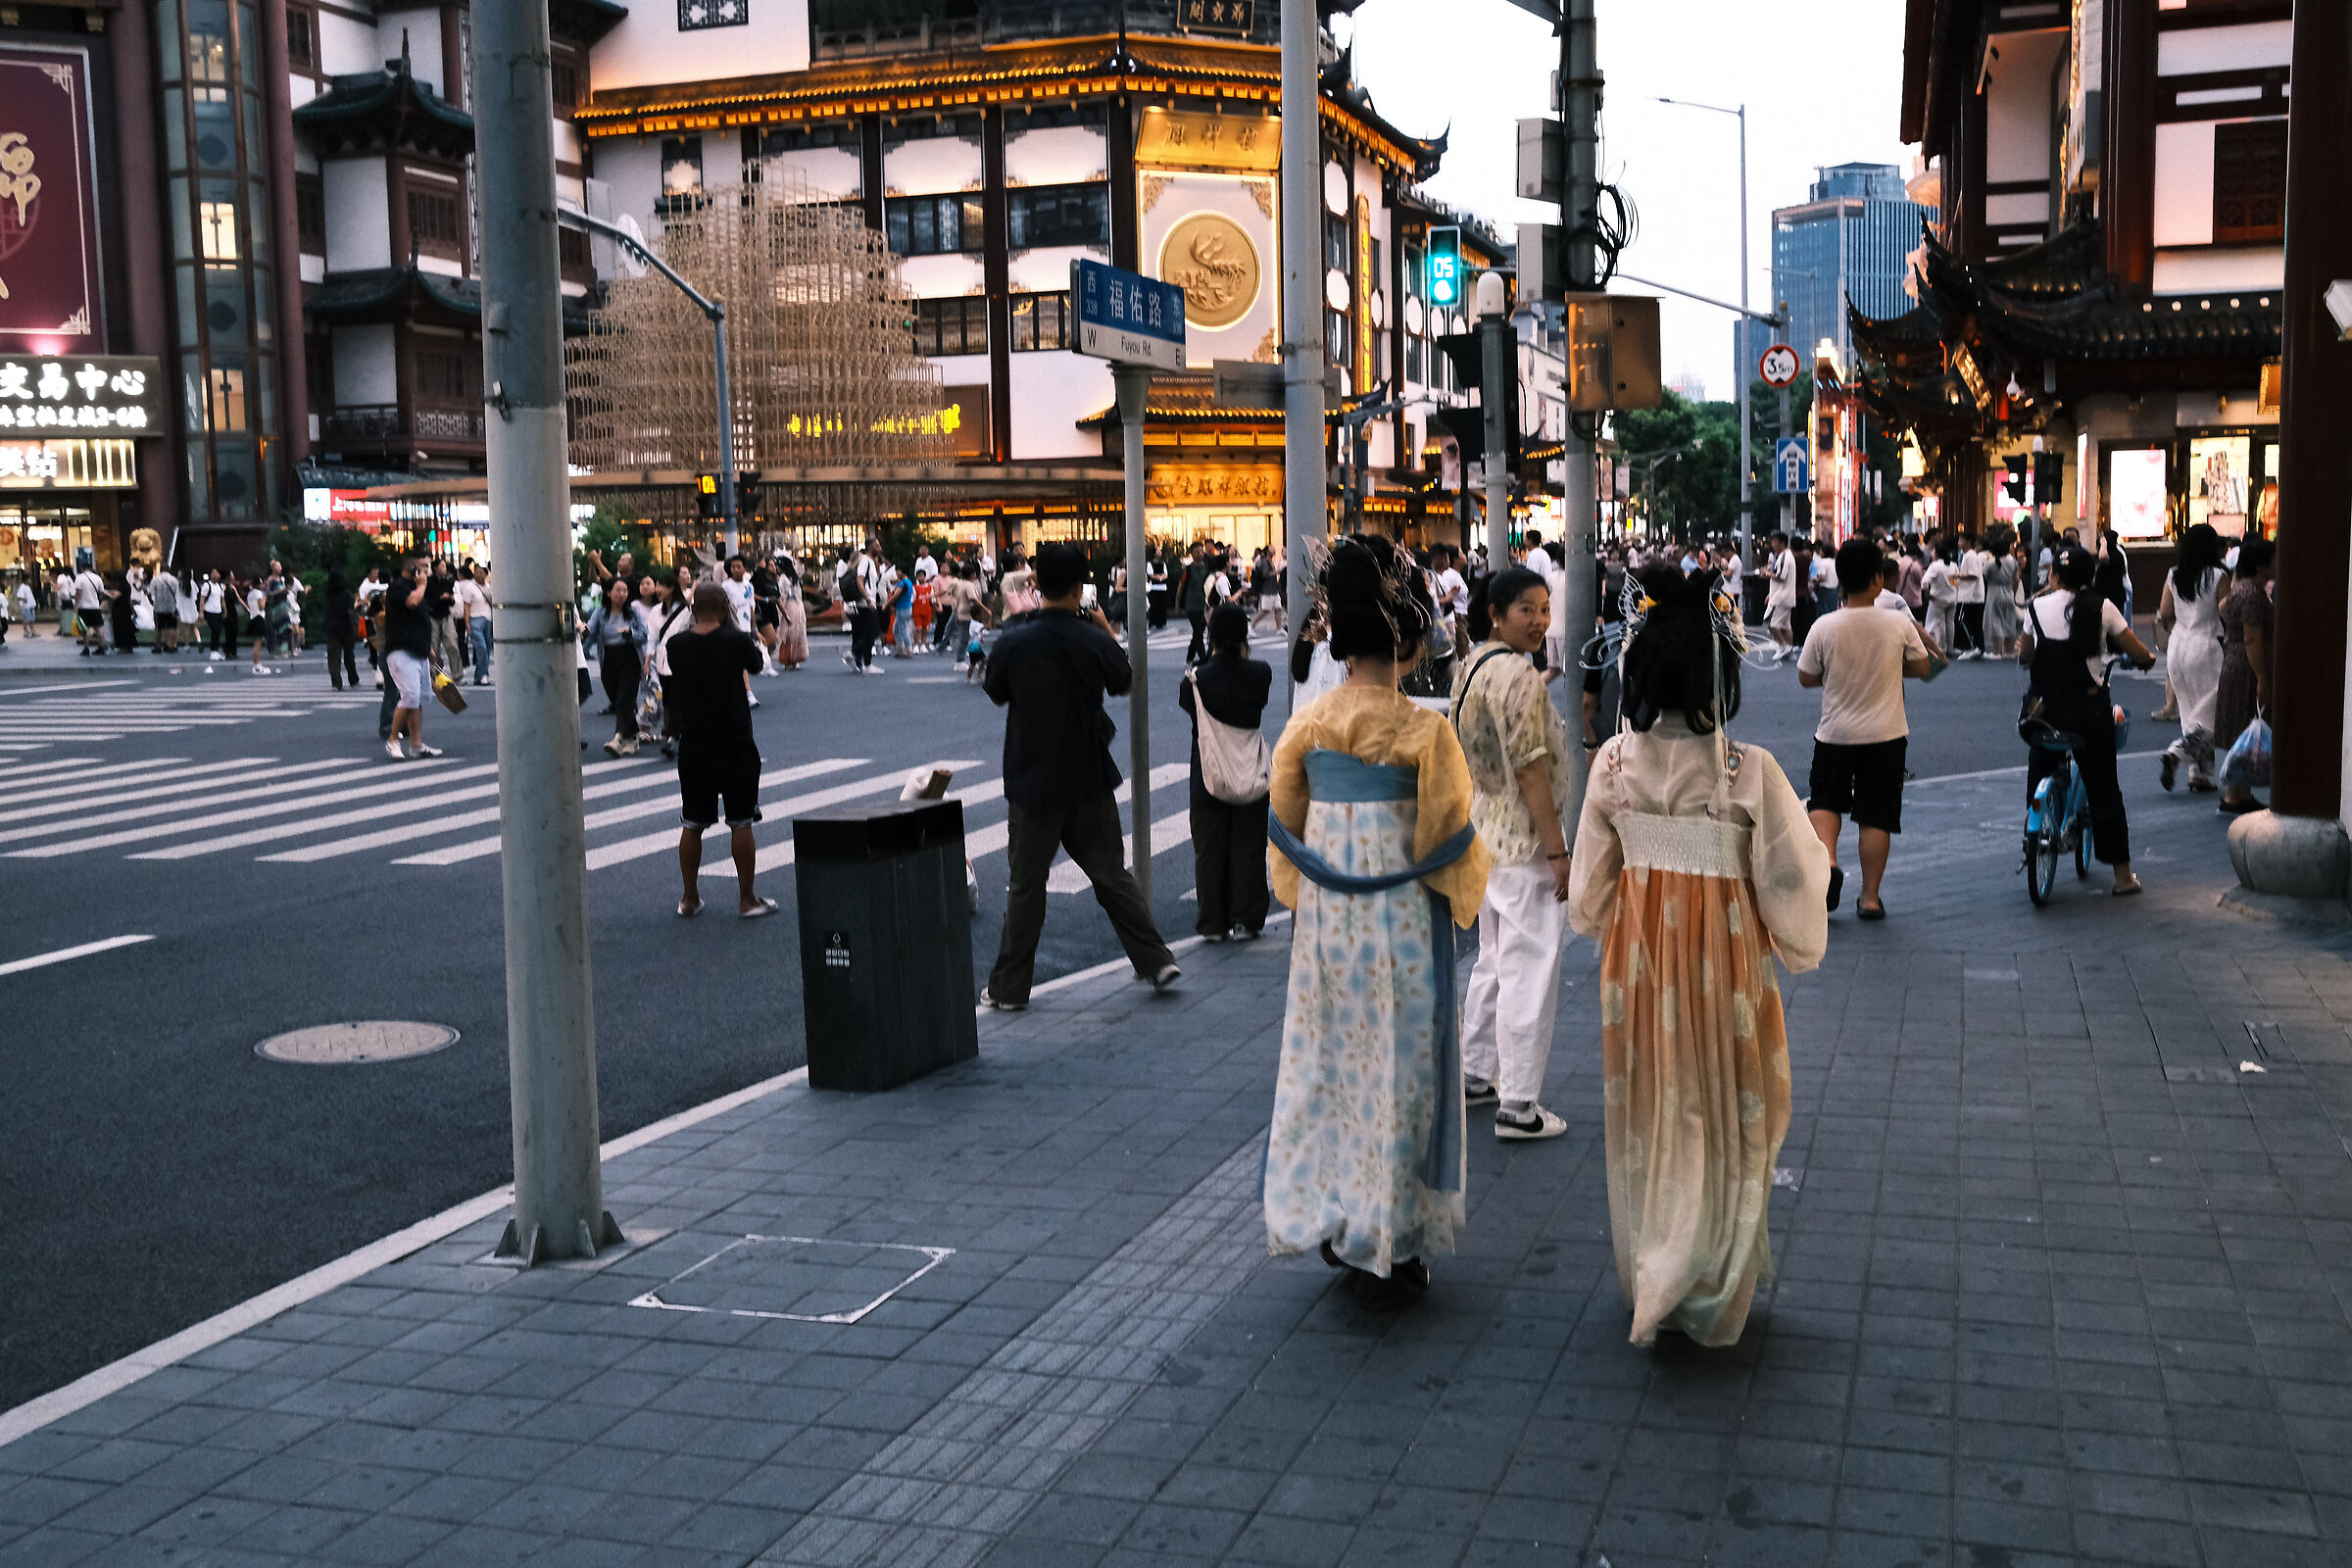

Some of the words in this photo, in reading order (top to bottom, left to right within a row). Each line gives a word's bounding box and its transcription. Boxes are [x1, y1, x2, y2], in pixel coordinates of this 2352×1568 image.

[1086, 270, 1097, 294] 西
[1109, 277, 1162, 329] 福佑路
[1087, 328, 1097, 348] W
[1121, 335, 1141, 355] Fuyou
[1142, 341, 1153, 357] Rd.
[1175, 348, 1181, 367] E
